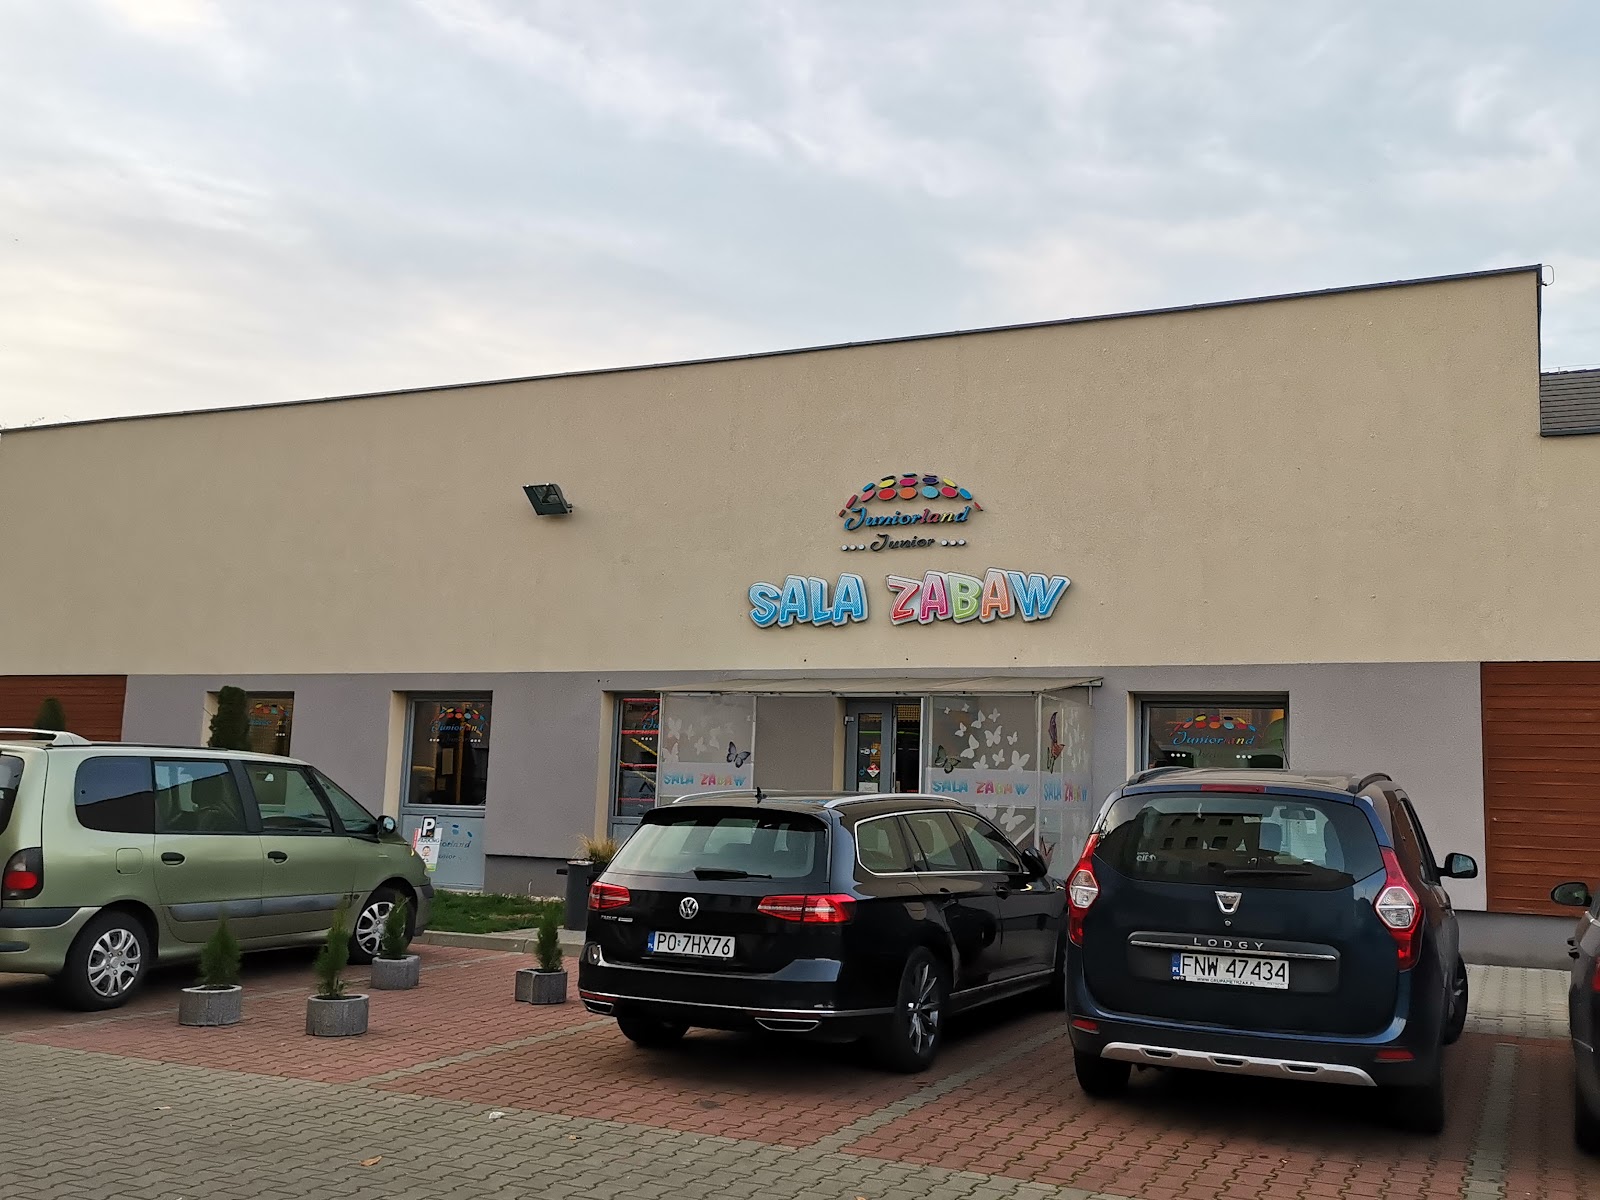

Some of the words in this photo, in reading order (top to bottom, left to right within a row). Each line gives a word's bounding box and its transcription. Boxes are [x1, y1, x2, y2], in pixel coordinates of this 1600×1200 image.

[844, 505, 971, 531] Juniorland
[870, 534, 936, 552] Junior
[749, 572, 868, 628] SALA
[886, 567, 1071, 626] ZABAW
[663, 773, 694, 785] SALA
[931, 780, 969, 793] SALA
[656, 933, 677, 951] PO
[682, 935, 732, 955] 7HX76
[1193, 937, 1264, 950] LODGY
[1181, 956, 1219, 977] FNW
[1225, 958, 1286, 983] 47434
